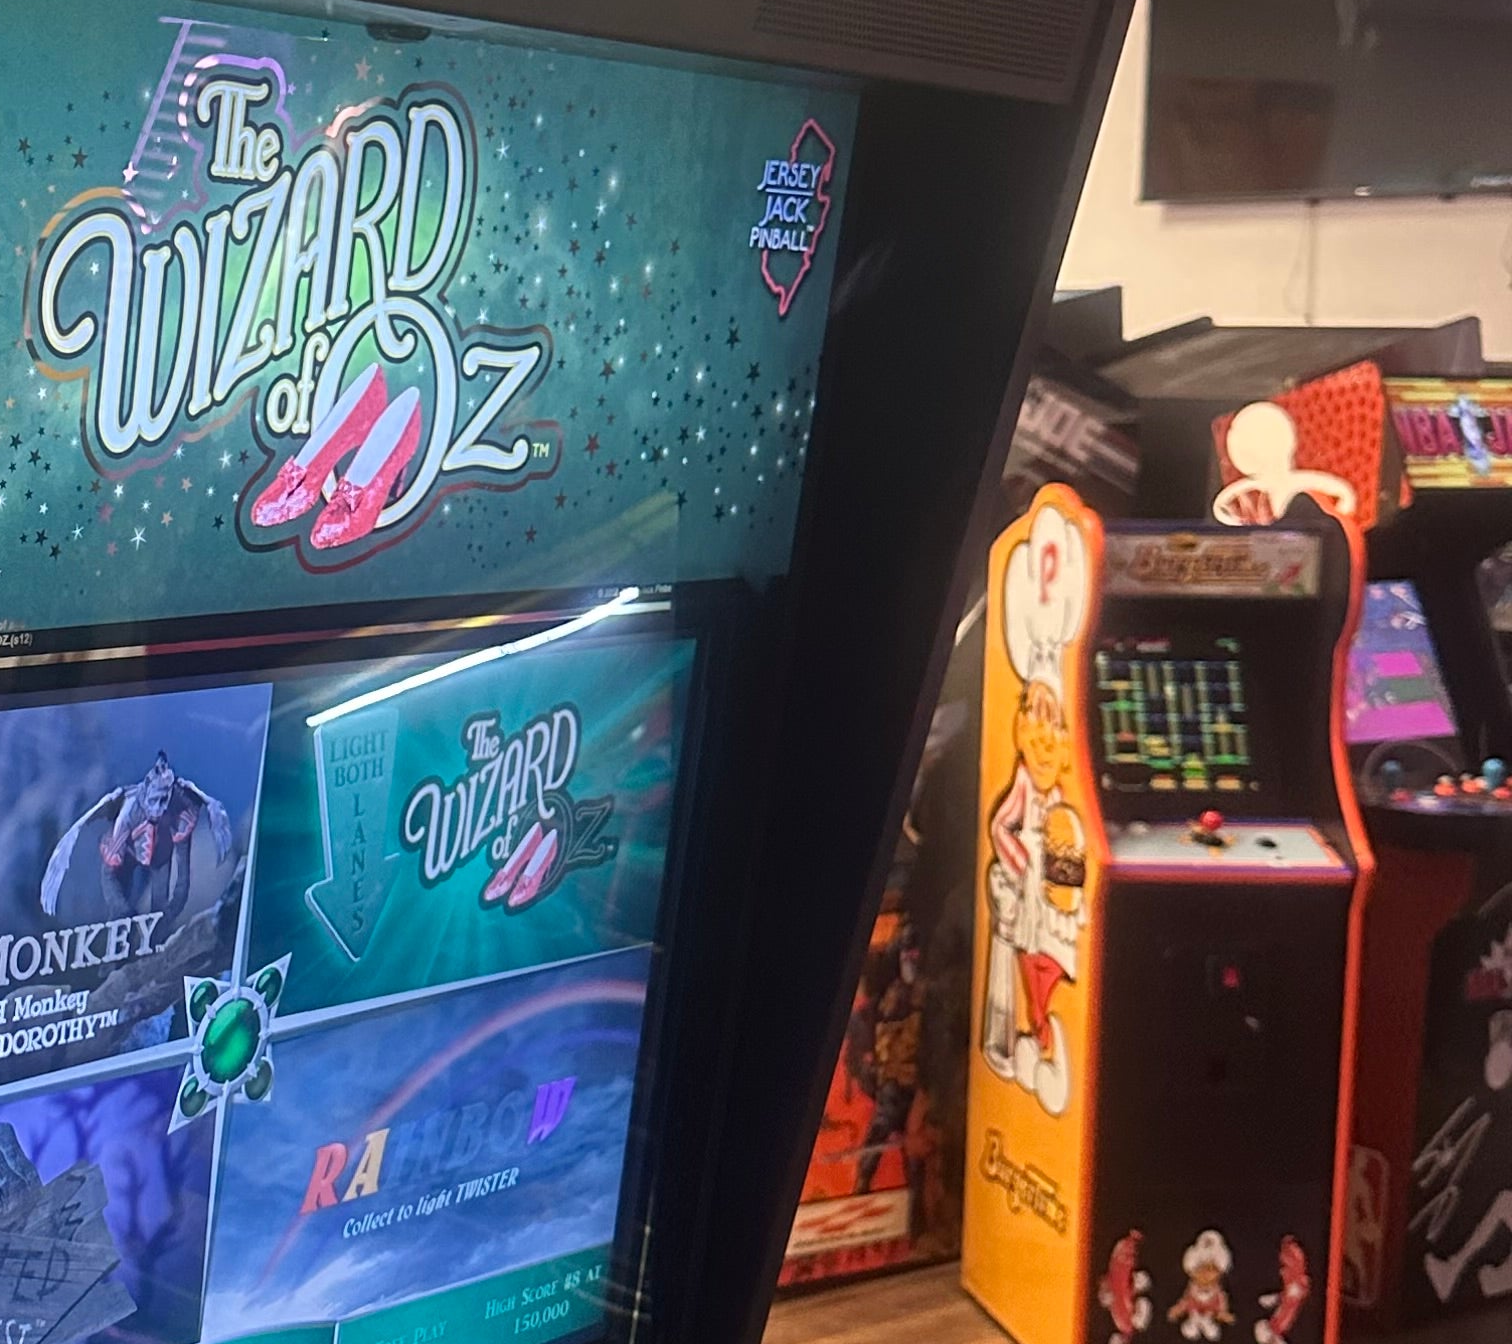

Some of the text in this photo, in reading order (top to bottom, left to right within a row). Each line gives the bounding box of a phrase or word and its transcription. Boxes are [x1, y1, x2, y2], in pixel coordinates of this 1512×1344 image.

[198, 78, 281, 181] The
[757, 159, 821, 190] JERSEY
[758, 194, 811, 227] JACK
[40, 103, 465, 455] WIZARD
[266, 330, 330, 438] of
[1392, 406, 1464, 457] NBA
[1038, 541, 1059, 605] P
[330, 730, 389, 763] LIGHT
[467, 718, 500, 761] The
[334, 757, 384, 788] BOTH
[404, 708, 578, 880] WIZARD
[349, 792, 366, 932] LANES
[491, 814, 518, 860] of
[13, 990, 90, 1024] Monkey
[342, 1166, 521, 1239] Collect to light TWISTER
[484, 1295, 517, 1321] HIGH
[521, 1279, 560, 1308] SCORE
[585, 1264, 604, 1282] AT
[513, 1299, 572, 1336] 150,000
